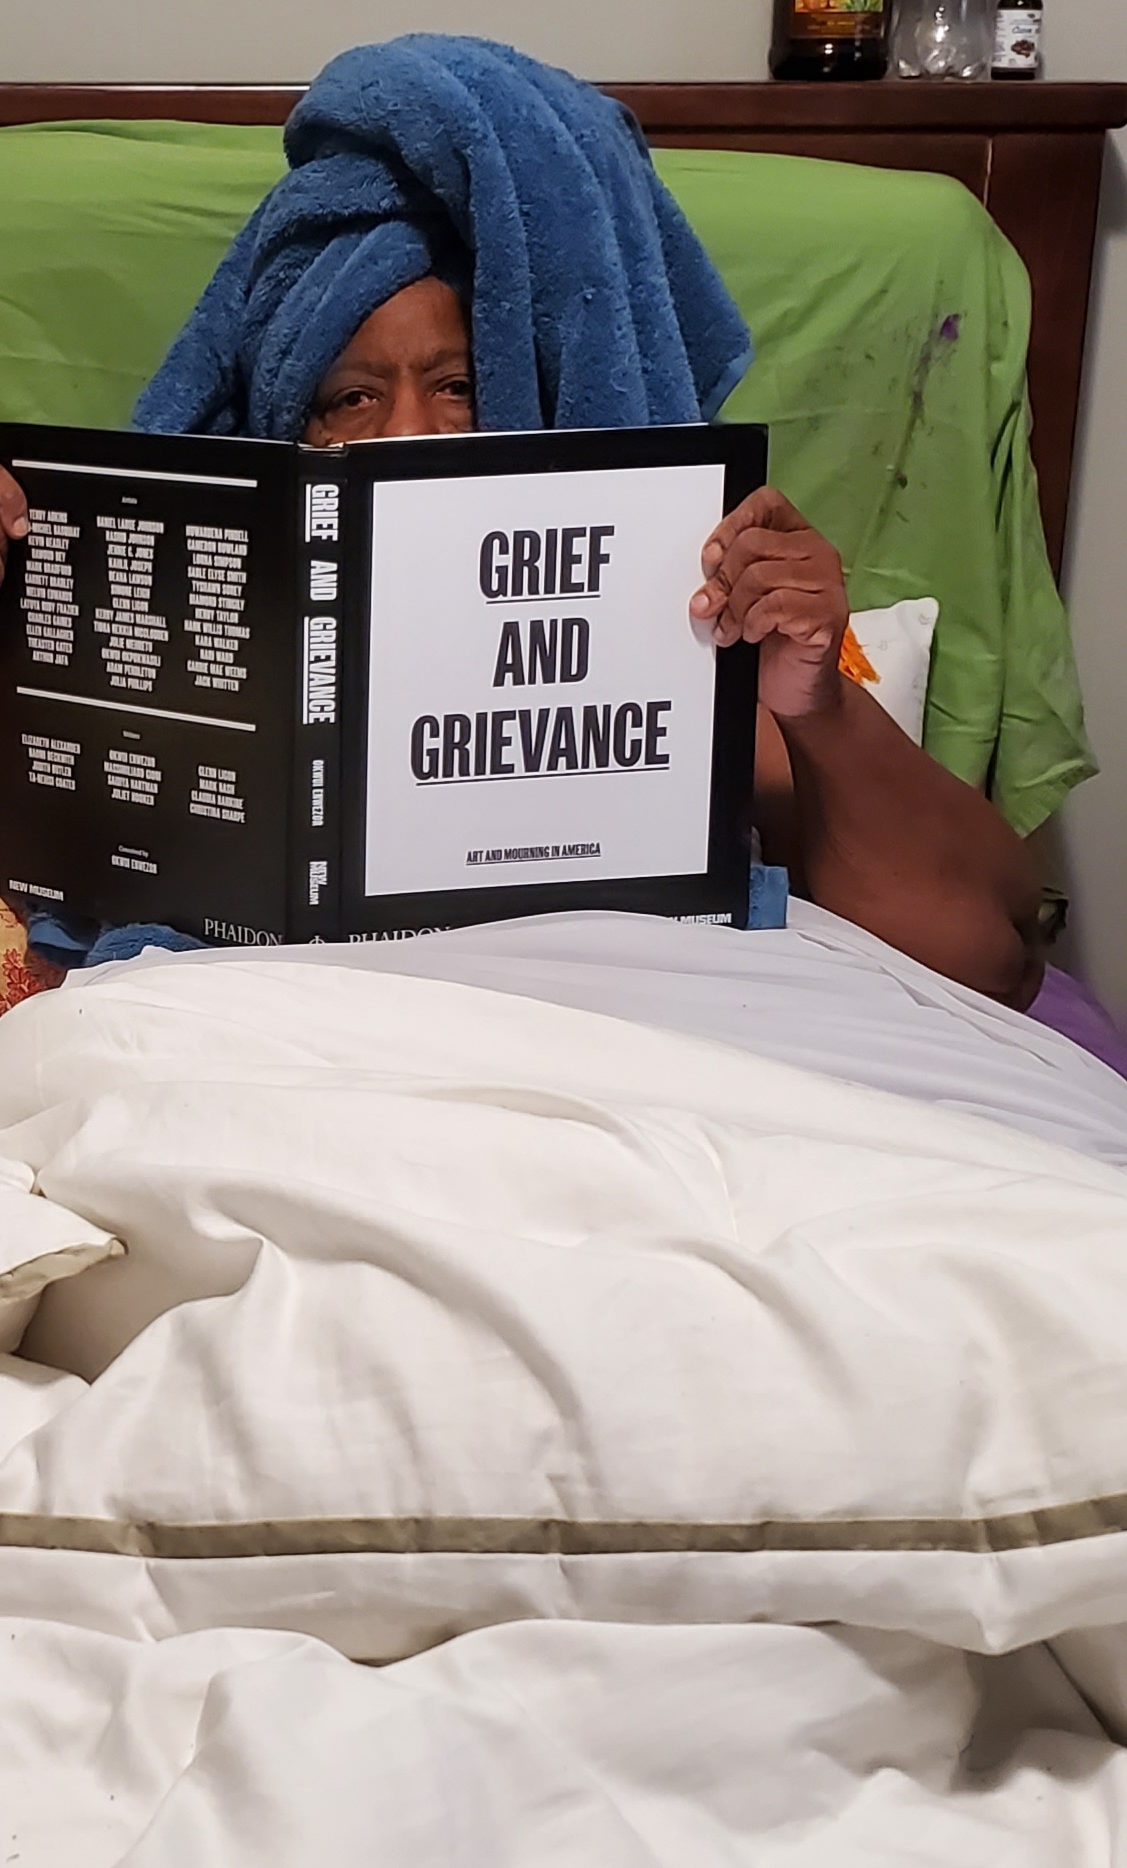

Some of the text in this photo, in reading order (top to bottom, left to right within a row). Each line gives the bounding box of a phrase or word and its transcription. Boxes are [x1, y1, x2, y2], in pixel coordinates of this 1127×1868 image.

[479, 525, 615, 599] GRIEF
[308, 484, 340, 724] GRIEF AND GRIEVANCE
[492, 617, 590, 688] AND
[410, 700, 672, 781] GRIEVANCE
[466, 842, 602, 864] ART AND MOURNING IN AMERICA
[9, 880, 64, 901] NEW MUSEUM
[204, 918, 283, 946] PHAIDON
[681, 912, 732, 927] MUSEUM
